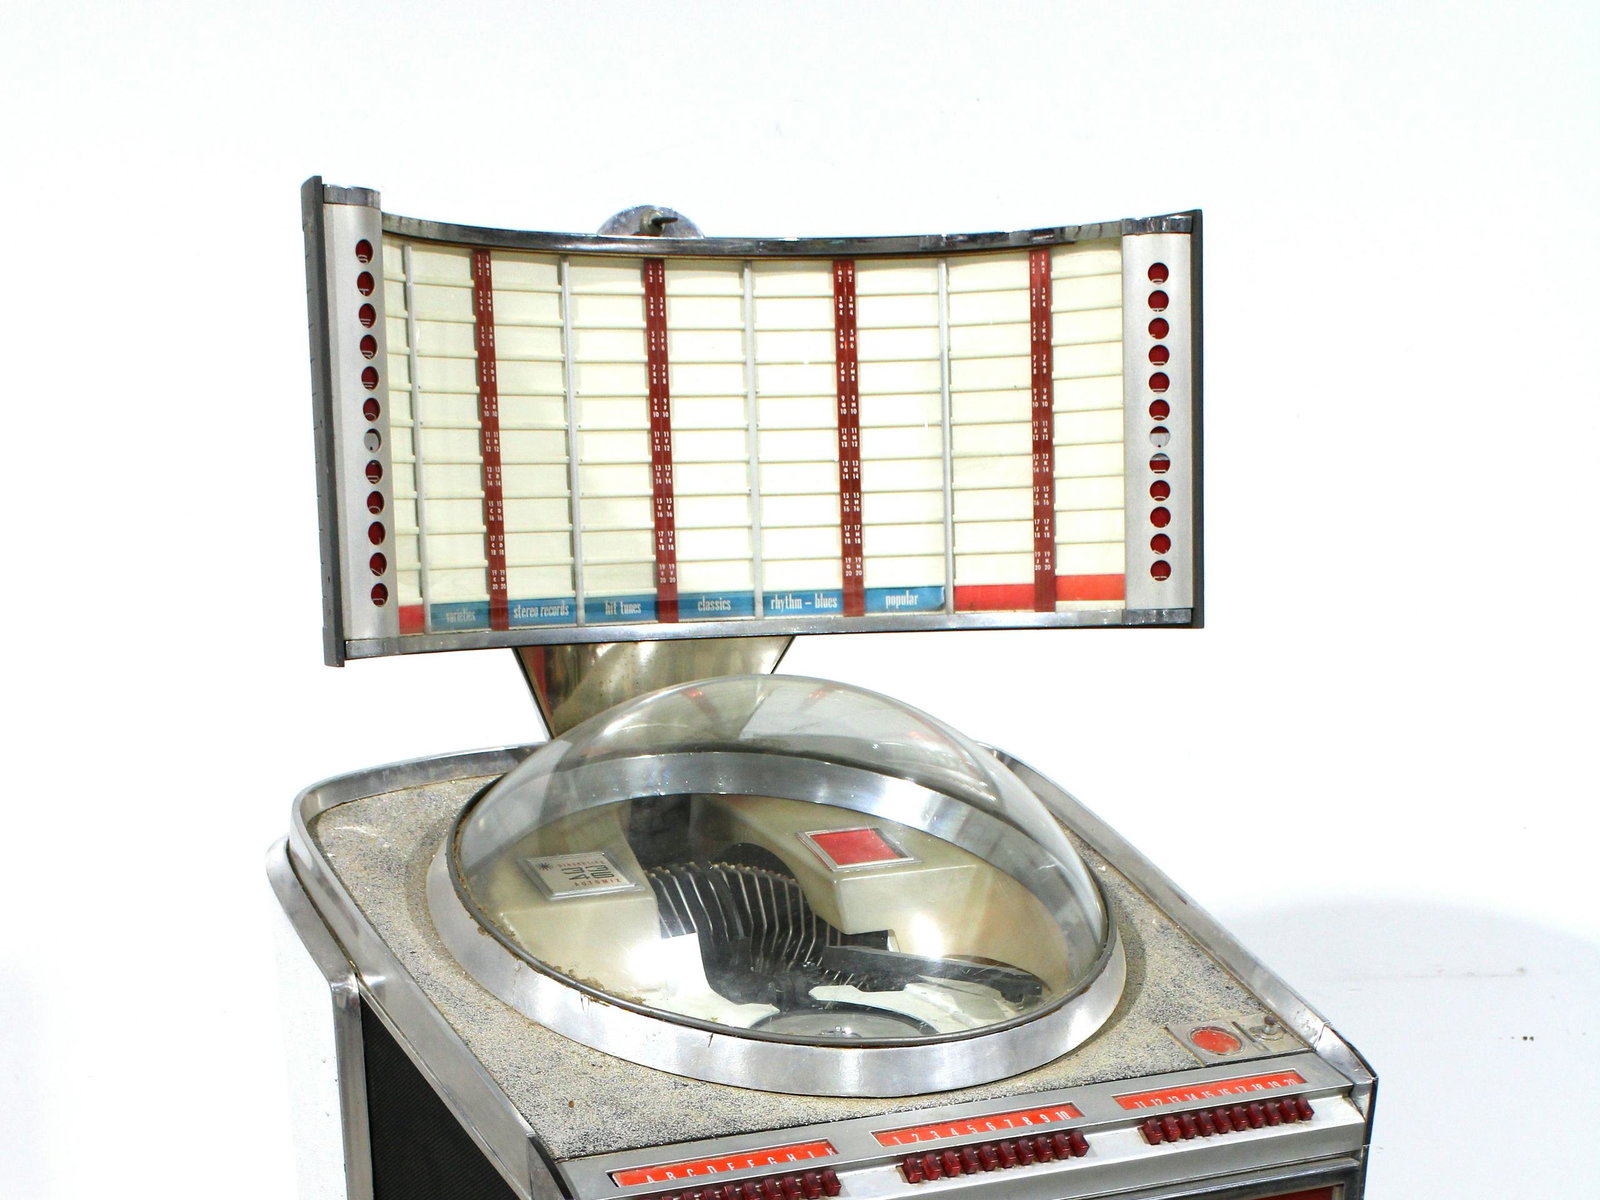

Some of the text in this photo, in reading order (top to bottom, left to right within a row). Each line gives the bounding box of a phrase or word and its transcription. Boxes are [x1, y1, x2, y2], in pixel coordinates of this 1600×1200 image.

[697, 597, 732, 612] classics
[771, 594, 803, 611] rhythm
[815, 594, 838, 609] blues
[885, 592, 919, 608] popular
[513, 602, 569, 618] stereo records
[605, 602, 642, 616] hit tunes
